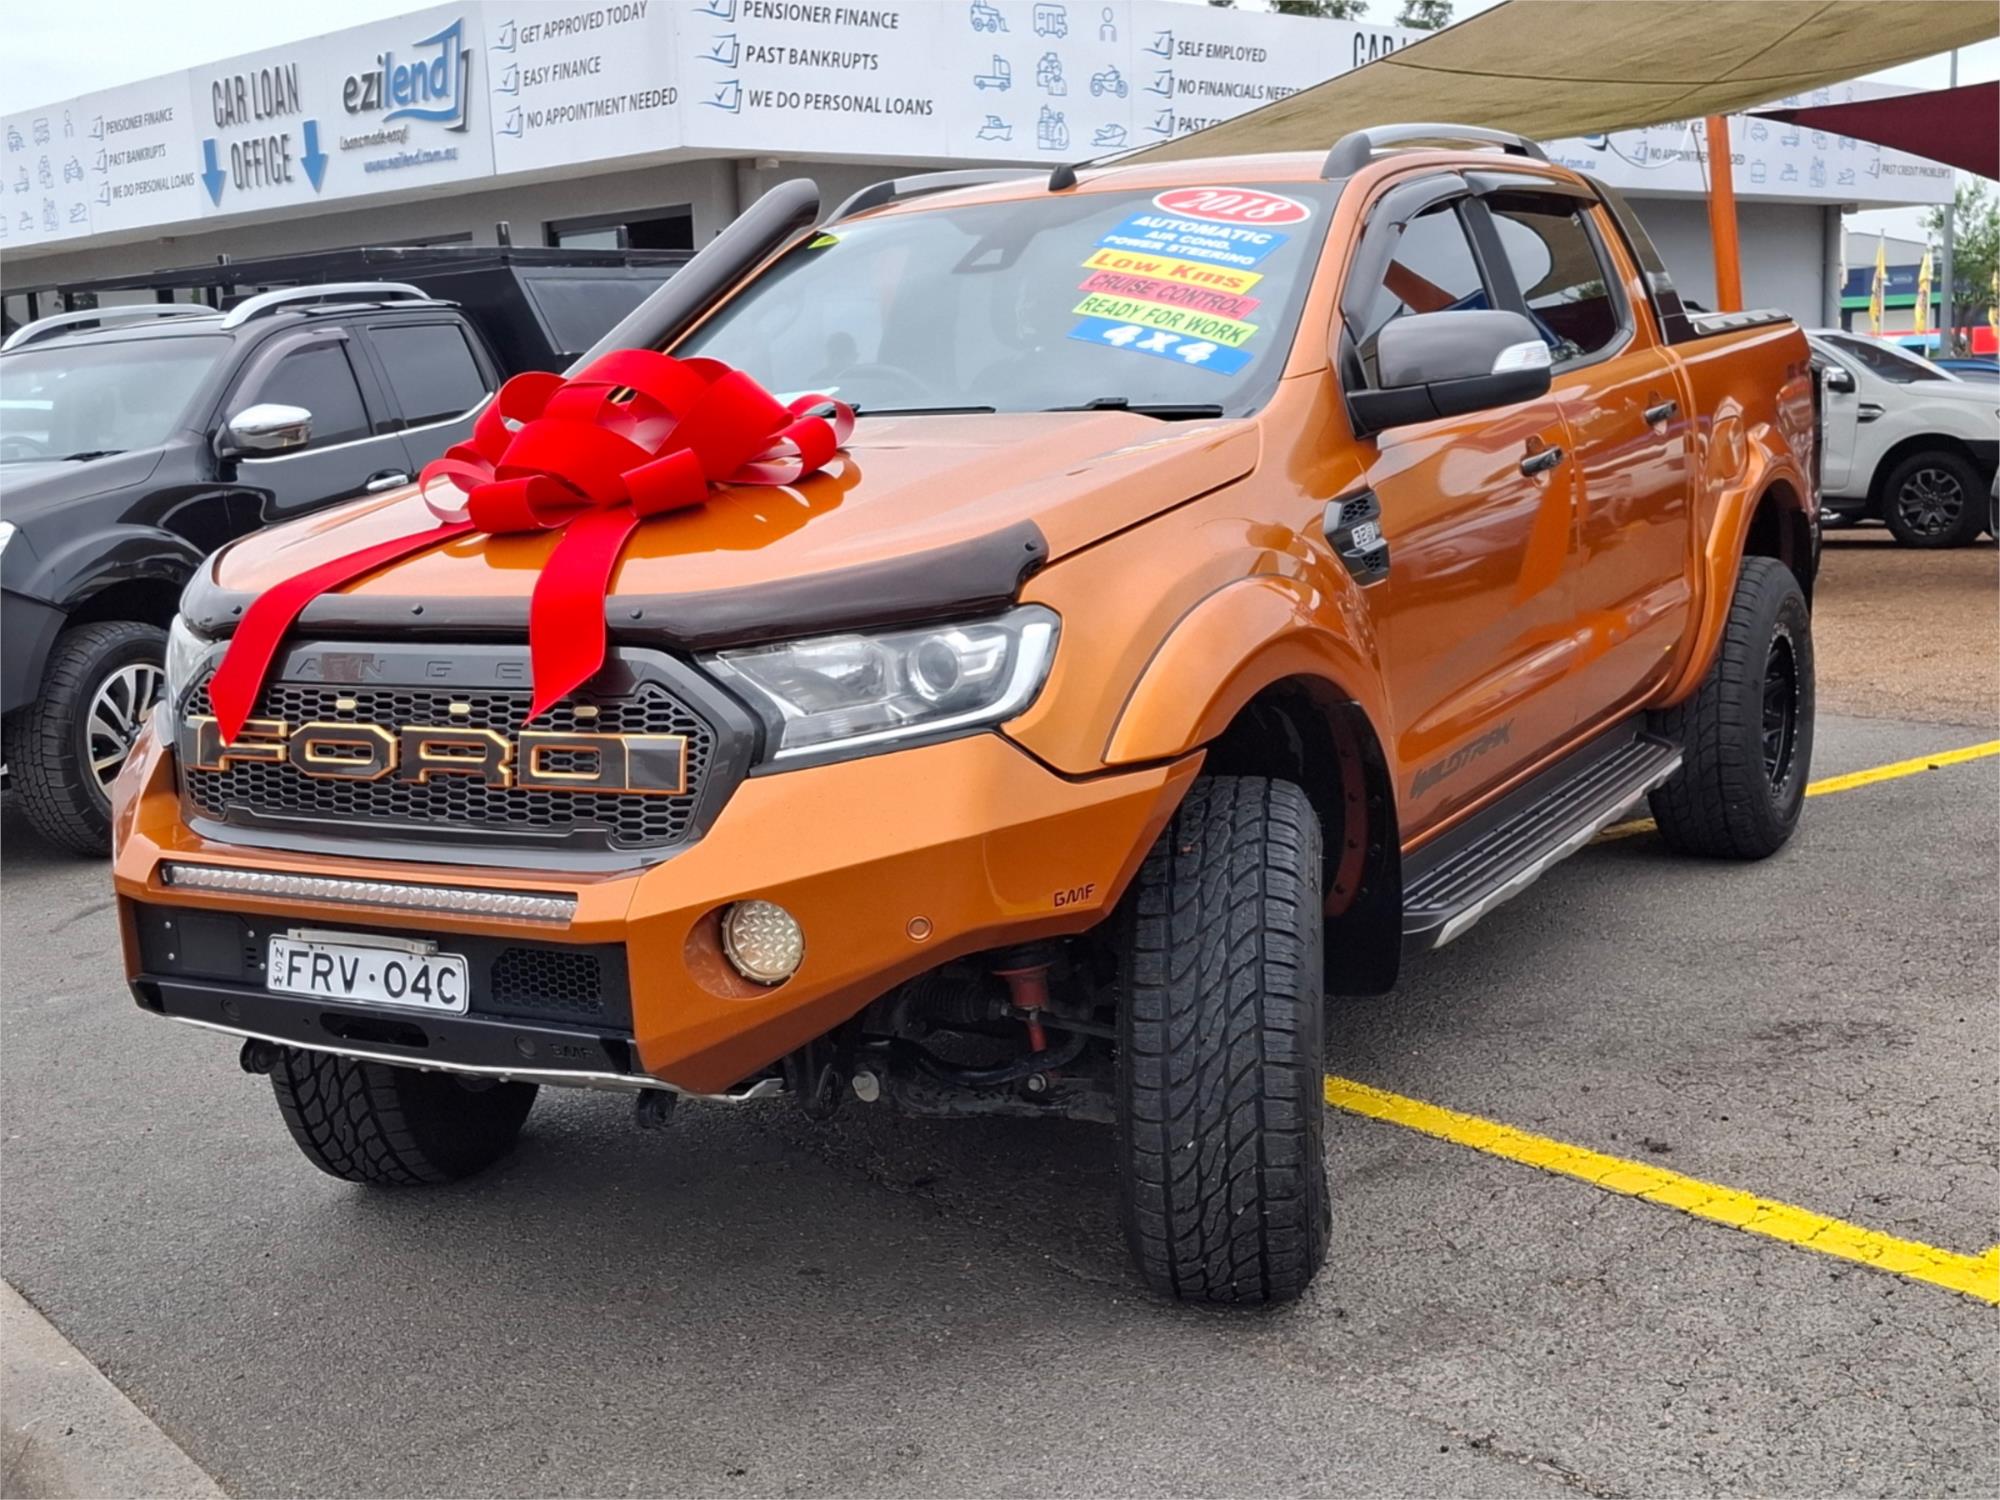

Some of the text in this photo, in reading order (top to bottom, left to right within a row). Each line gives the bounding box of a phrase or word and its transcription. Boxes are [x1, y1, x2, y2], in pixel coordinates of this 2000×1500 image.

[520, 0, 648, 44] GET APPROVED TODAY
[743, 1, 900, 30] PENSIONER FINANCE
[745, 45, 879, 70] PAST BANKRUPTS
[1177, 40, 1267, 63] SELF EMPLOYED
[342, 40, 450, 115] ezilend
[523, 56, 602, 87] EASY FINANCE
[212, 62, 302, 129] CAR LOAN
[748, 90, 934, 116] WE DO PERSONAL LOANS
[1177, 79, 1196, 95] NO
[1198, 80, 1264, 100] FINANCIALS
[105, 107, 174, 135] PENSIONER FINANCE
[526, 87, 678, 129] NO APPOINTMENT NEEDED
[108, 143, 166, 167] PAST BANKRUPTS
[231, 133, 294, 190] OFFICE
[135, 177, 170, 195] PERSONAL
[170, 172, 195, 190] LOANS
[1170, 191, 1295, 220] 2018
[1131, 215, 1274, 246] AUTOMATIC
[1143, 230, 1232, 251] AIR COND.
[1102, 235, 1257, 266] POWER STEERING
[1087, 273, 1245, 316] CRUISE CONTROL
[1080, 296, 1250, 344] READY FOR WORK
[185, 713, 689, 796] FORD
[1053, 883, 1096, 908] GMF
